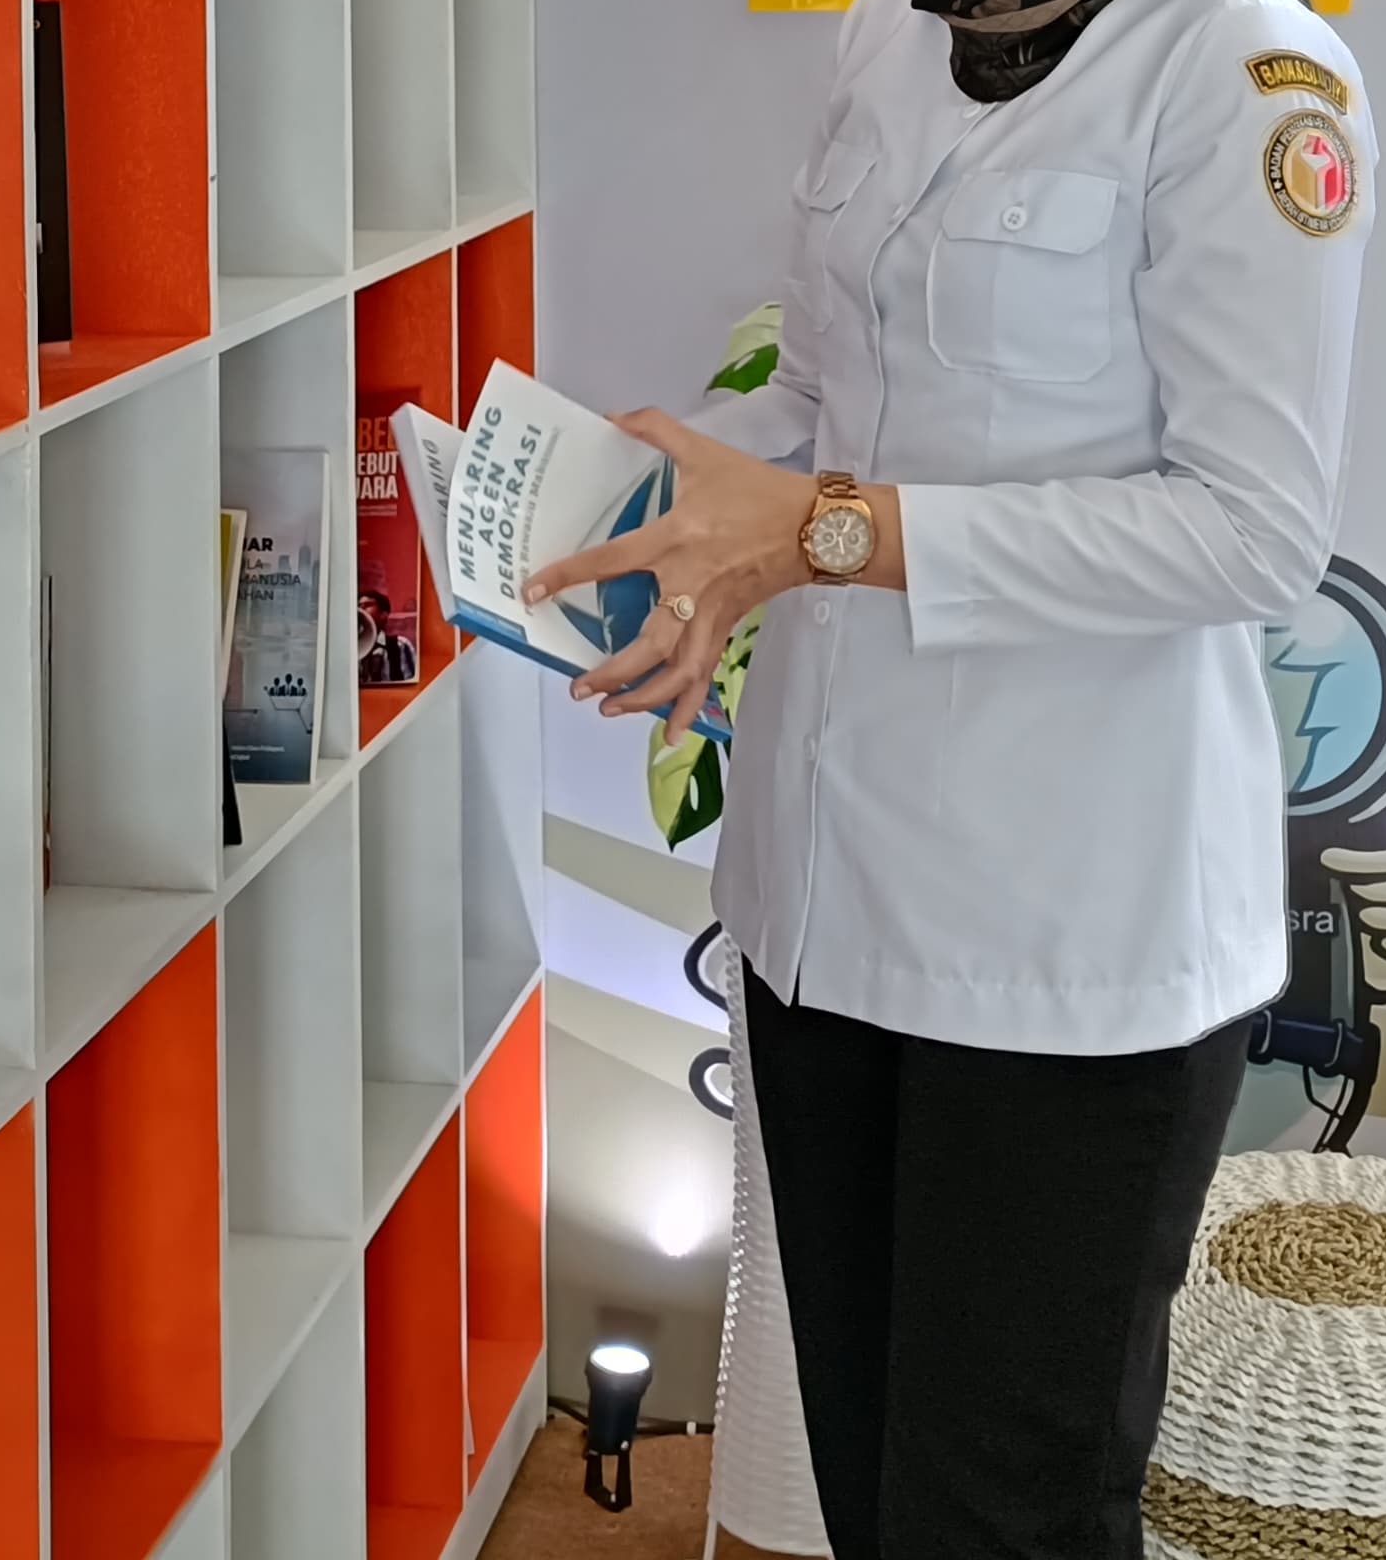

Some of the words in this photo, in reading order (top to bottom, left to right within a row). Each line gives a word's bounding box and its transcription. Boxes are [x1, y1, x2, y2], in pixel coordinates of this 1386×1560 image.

[1269, 143, 1285, 180] BADAN
[457, 405, 502, 582] MENJARING
[478, 461, 506, 547] AGEN
[498, 423, 542, 600] DEMOKRASI
